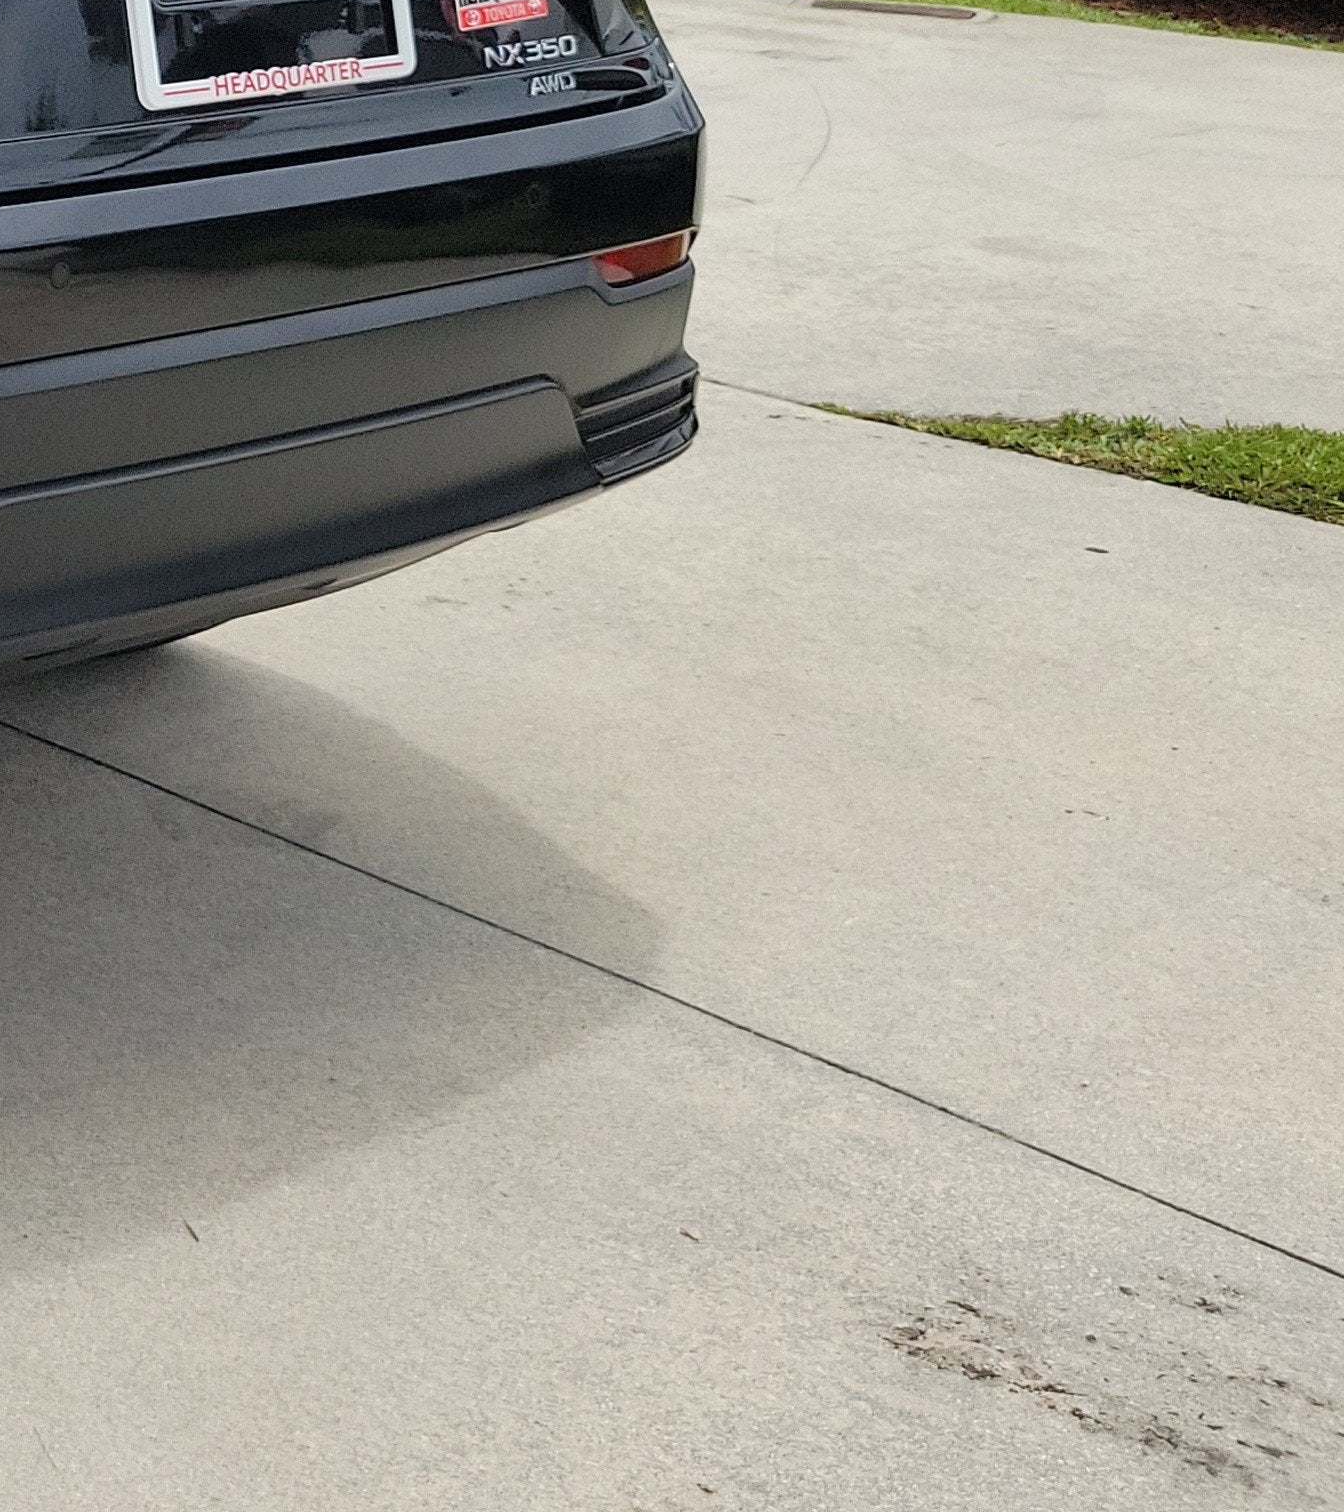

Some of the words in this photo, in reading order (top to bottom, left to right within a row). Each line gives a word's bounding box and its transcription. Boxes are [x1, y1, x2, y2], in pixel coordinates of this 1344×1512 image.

[482, 2, 526, 23] TOYOTA
[213, 60, 363, 97] HEADQUARTER
[529, 71, 577, 97] AWD
